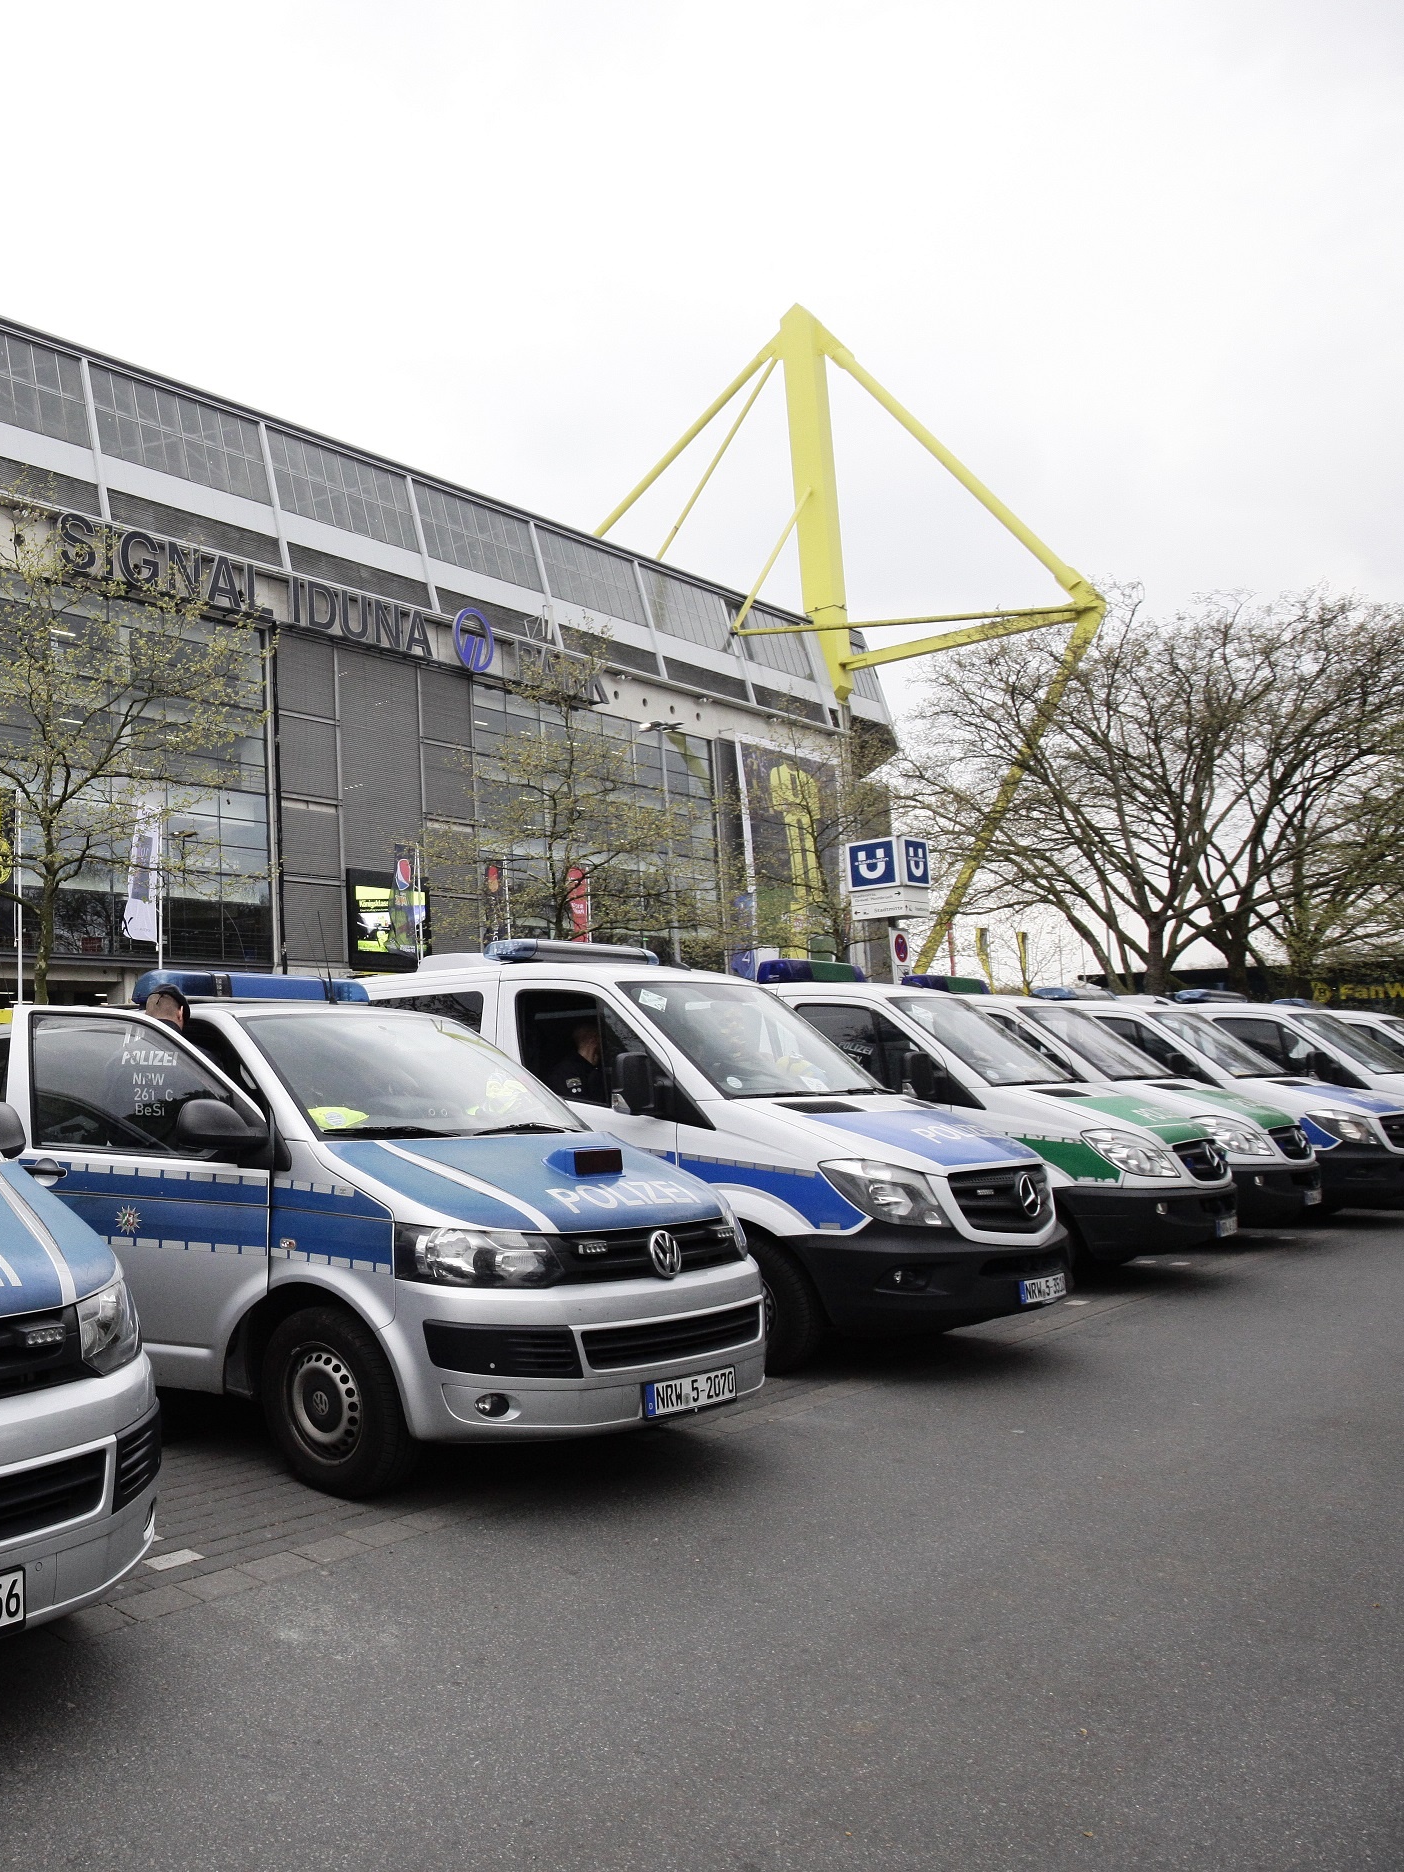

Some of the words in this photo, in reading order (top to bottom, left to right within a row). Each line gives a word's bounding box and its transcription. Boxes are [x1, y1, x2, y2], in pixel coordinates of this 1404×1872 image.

[58, 512, 274, 616] SIGNAL
[292, 575, 434, 658] IDUNA
[838, 1041, 874, 1055] POLIZEI
[121, 1050, 178, 1066] POLIZEI
[132, 1072, 165, 1086] NRW
[136, 1103, 165, 1116] BeSi
[545, 1181, 702, 1214] POLIZEI
[656, 1382, 683, 1410] NRW
[691, 1370, 734, 1403] 5-2070
